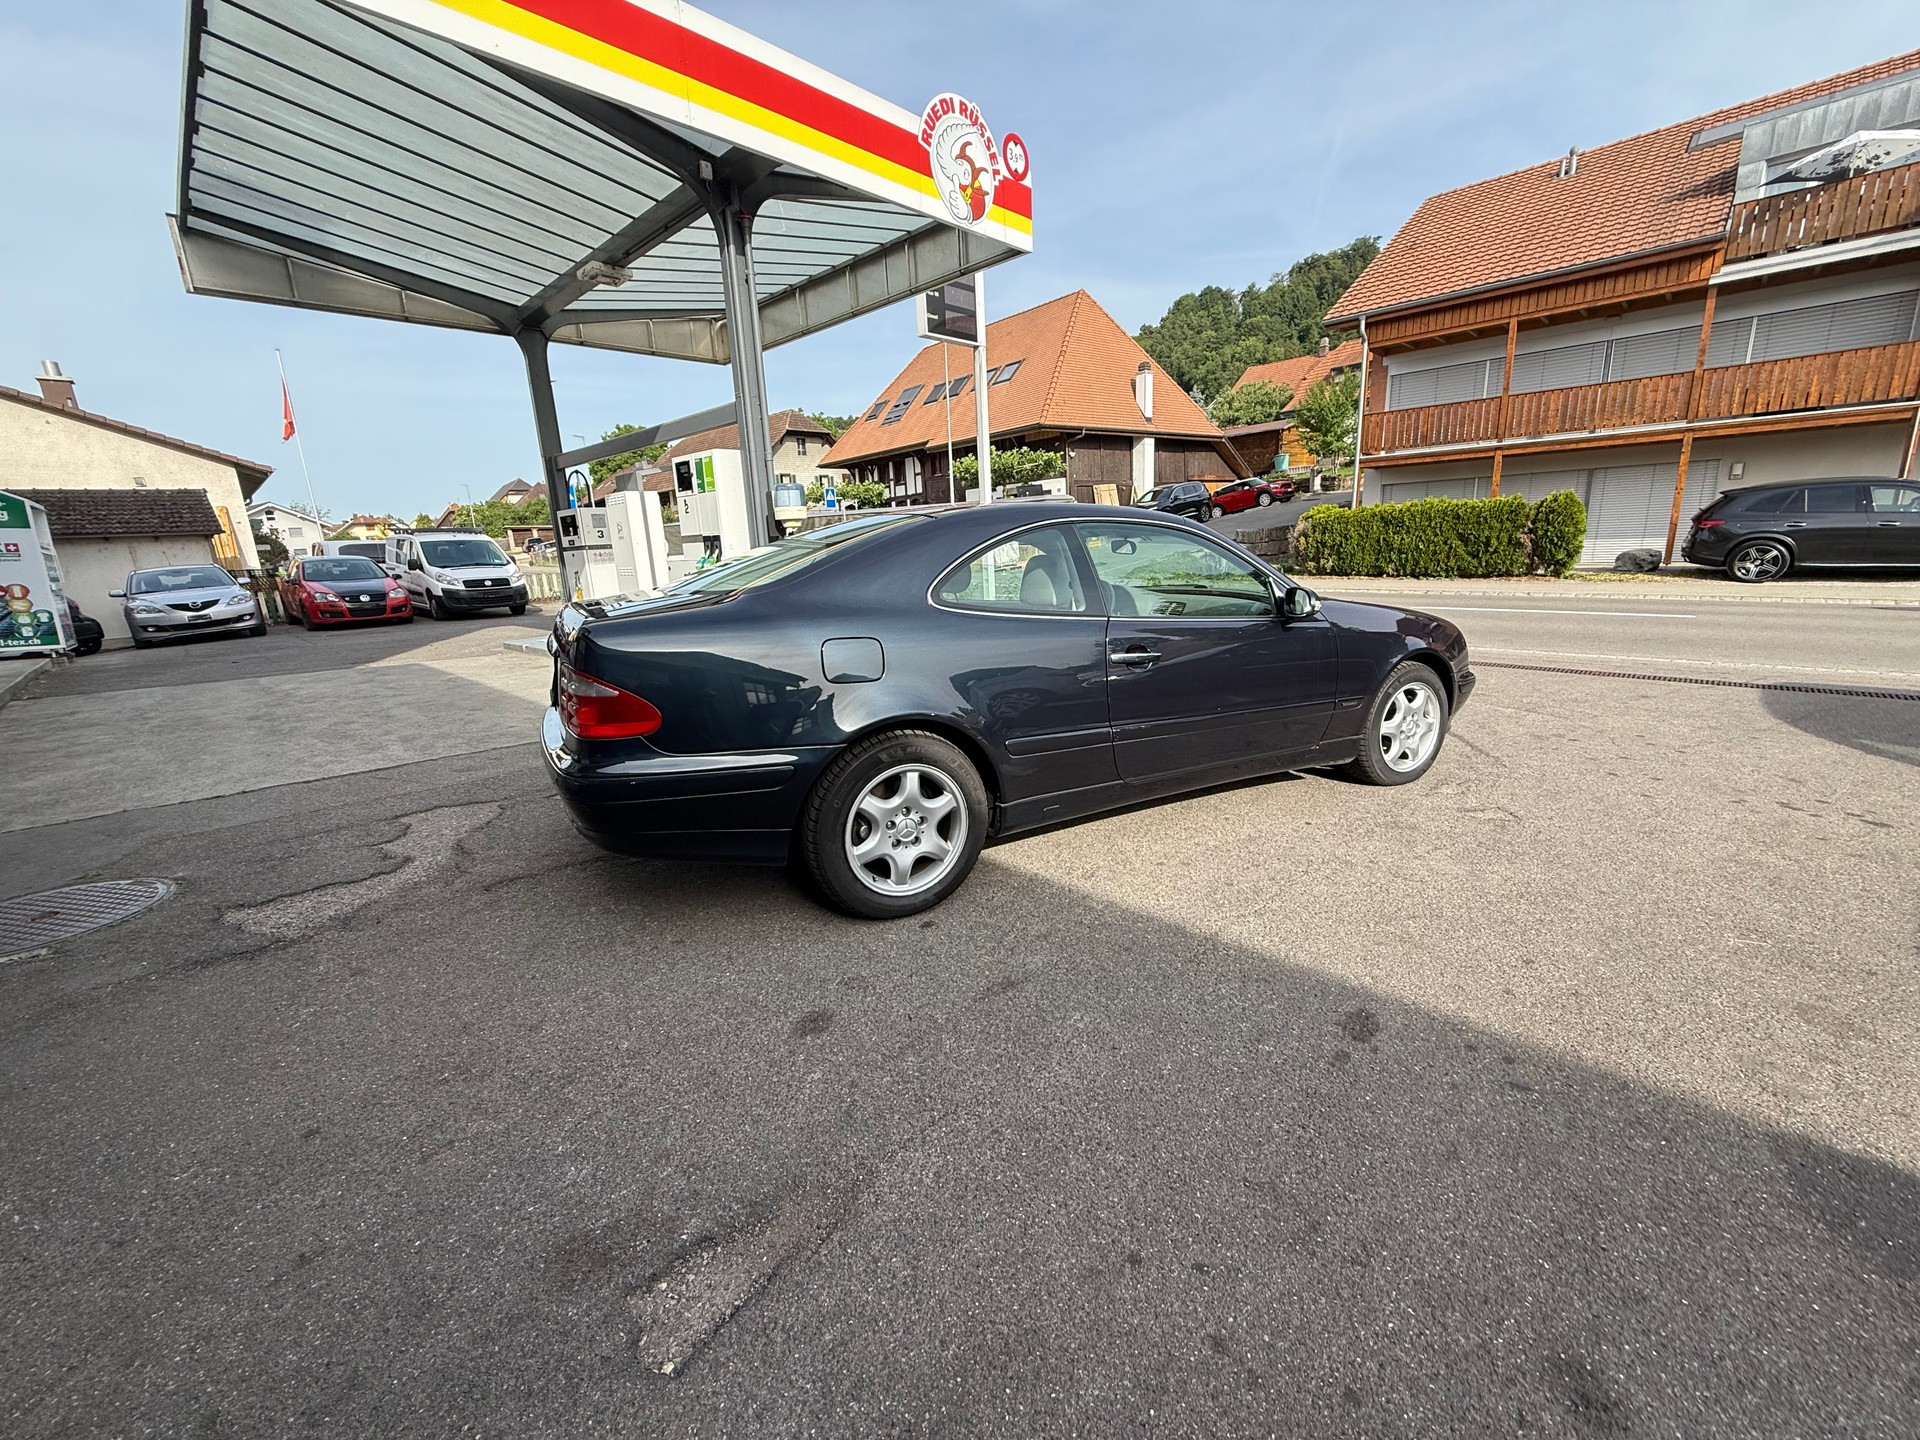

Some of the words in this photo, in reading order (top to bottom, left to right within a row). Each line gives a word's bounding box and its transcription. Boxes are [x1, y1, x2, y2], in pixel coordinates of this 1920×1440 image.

[921, 96, 956, 148] RUEDI
[959, 98, 1004, 183] RÜSSEL
[597, 530, 605, 539] 3
